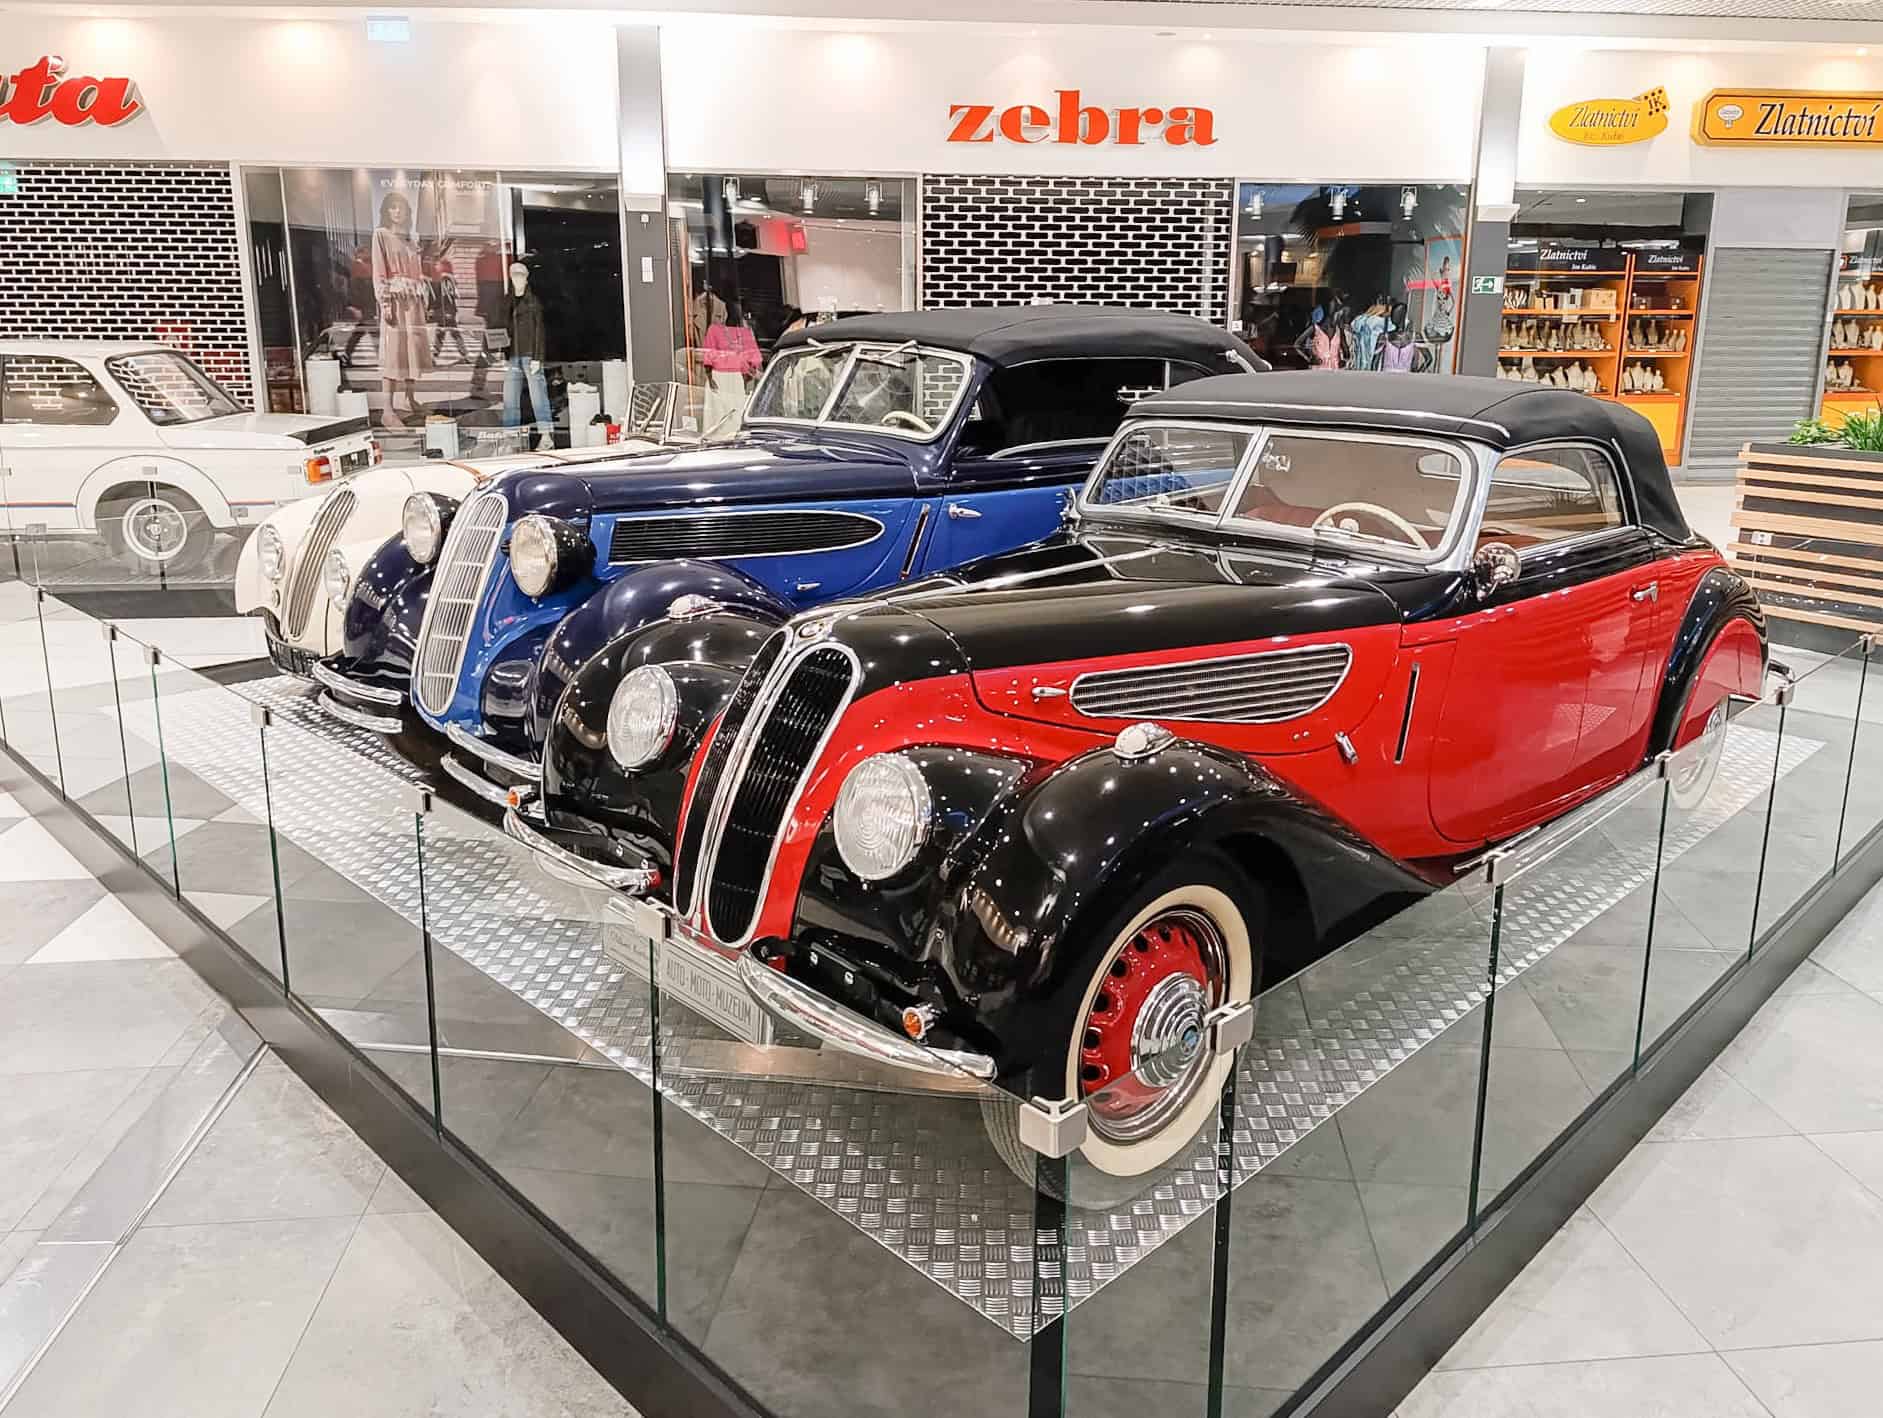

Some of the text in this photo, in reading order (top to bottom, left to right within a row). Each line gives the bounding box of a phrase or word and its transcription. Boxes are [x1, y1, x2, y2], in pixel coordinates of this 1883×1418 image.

[947, 89, 1218, 146] zebra
[1568, 105, 1640, 128] Zlatnictví
[1754, 103, 1881, 137] Zlatnictví
[1540, 249, 1588, 260] Zlatnictví
